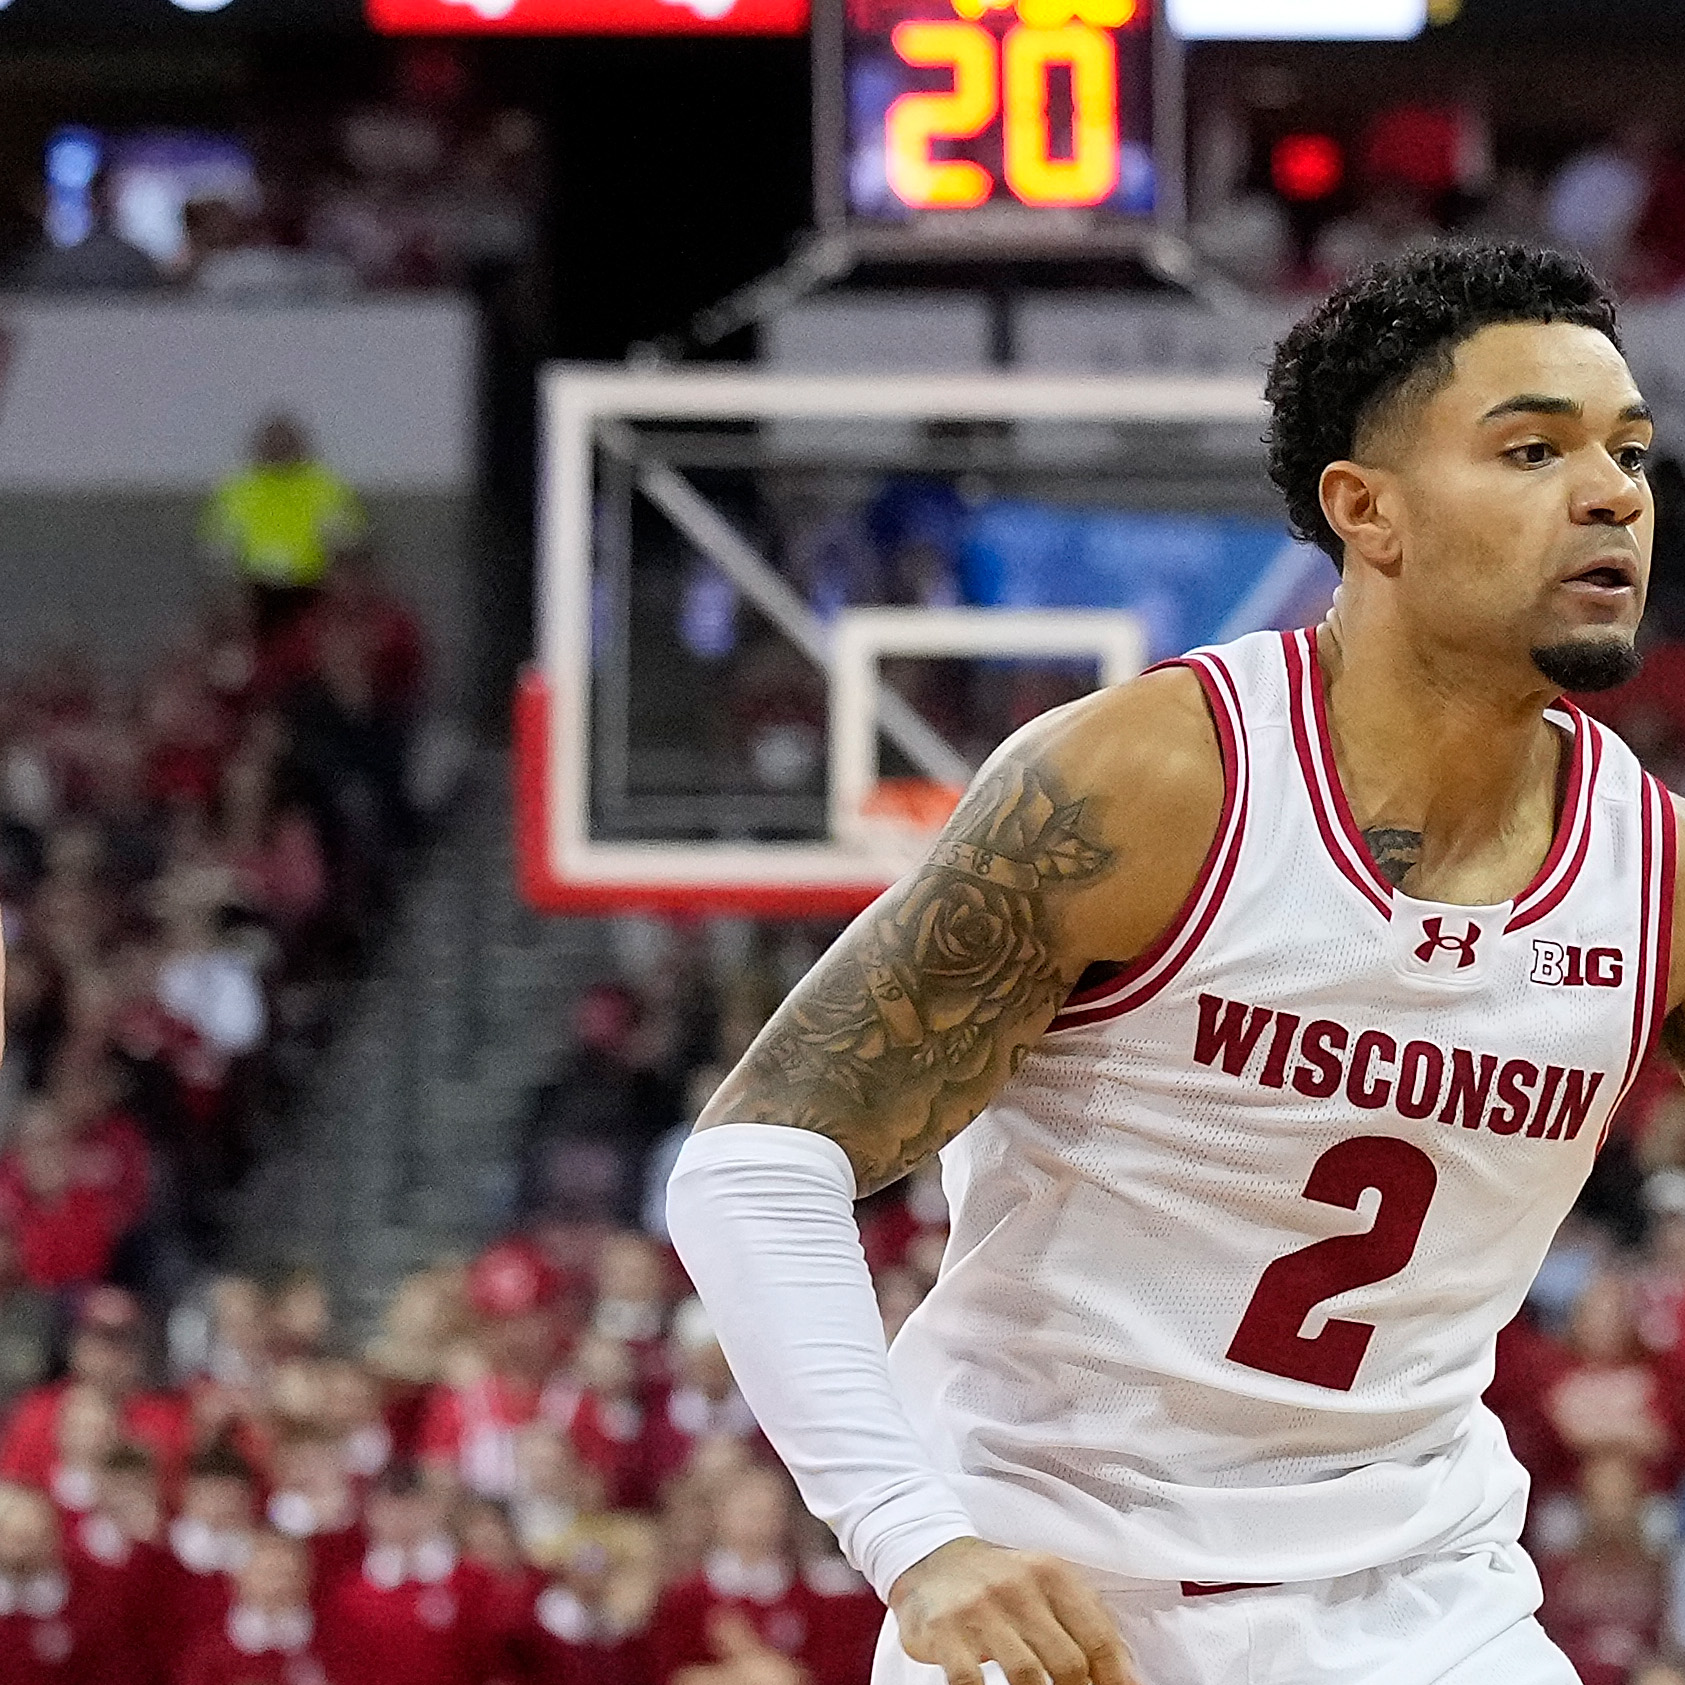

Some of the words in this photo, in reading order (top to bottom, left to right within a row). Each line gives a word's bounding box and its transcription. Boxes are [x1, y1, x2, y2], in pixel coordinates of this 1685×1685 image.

[885, 19, 1121, 208] 20
[1193, 993, 1604, 1142] WISCONSIN
[1226, 1135, 1438, 1392] 2
